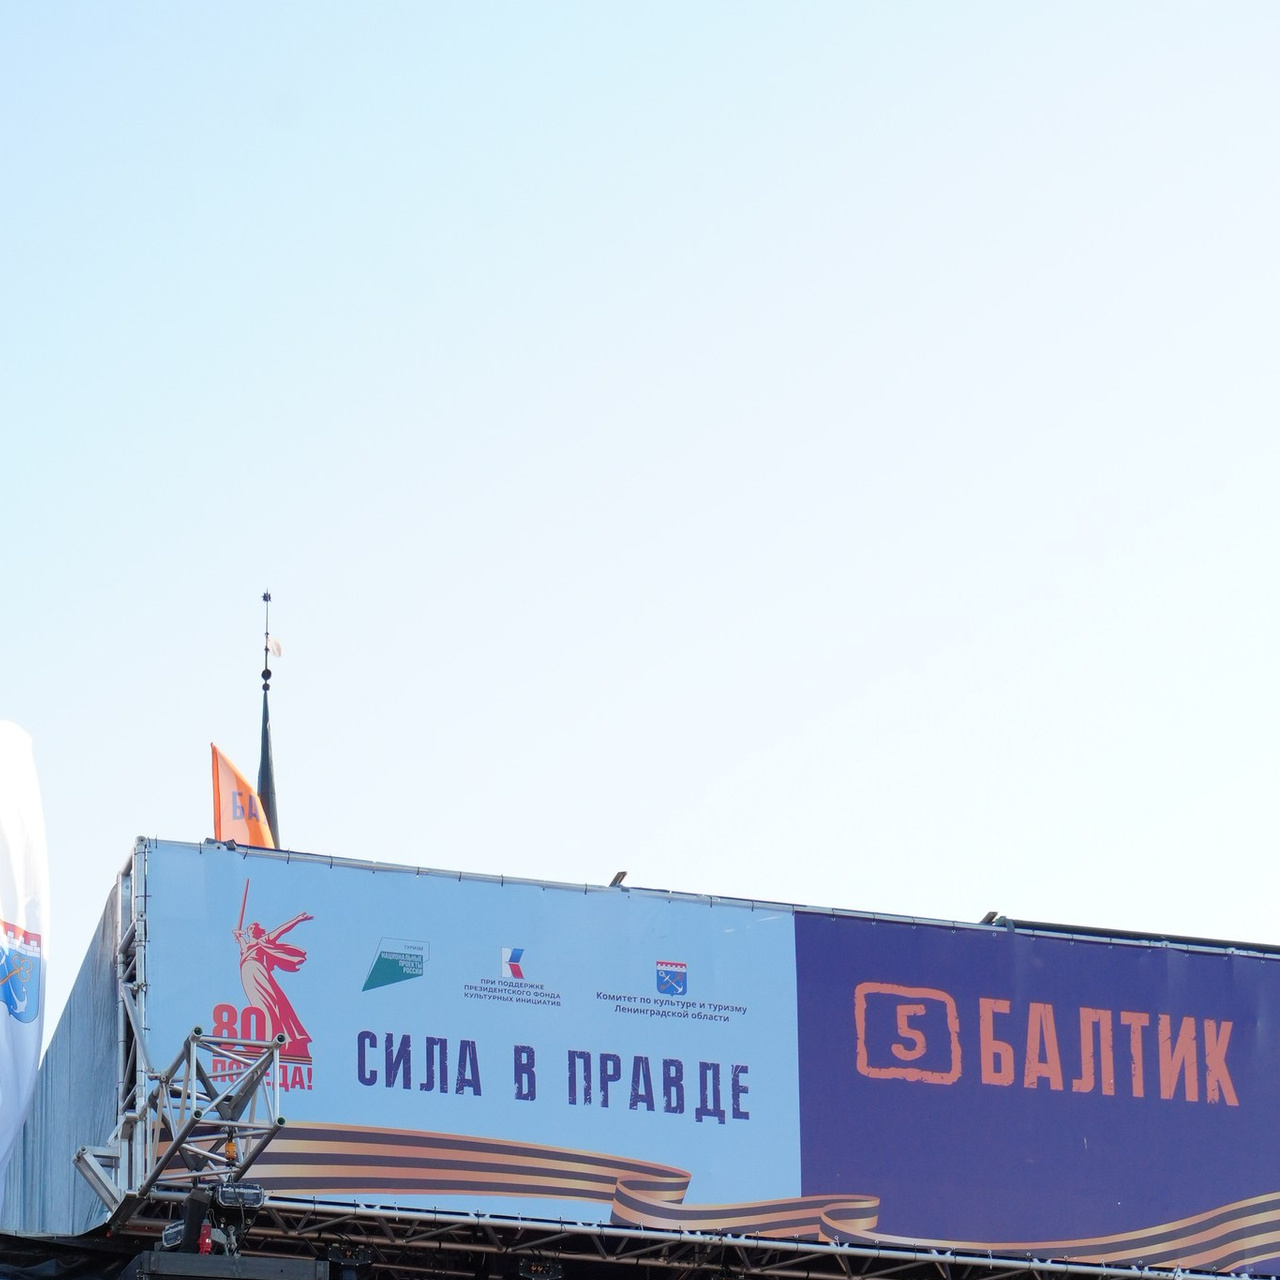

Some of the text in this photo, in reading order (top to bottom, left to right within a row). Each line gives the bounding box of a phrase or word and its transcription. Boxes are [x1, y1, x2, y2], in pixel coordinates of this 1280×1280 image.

[398, 960, 423, 969] ПРОЕКТЫ
[403, 967, 423, 975] РОССИИ
[464, 984, 561, 1000] ПРЕЗИДЕНТСКОГО ФОНДА
[480, 978, 545, 990] ПРИ ПОДДЕРЖКЕ
[464, 992, 561, 1007] КУЛЬТУРНЫХ ИНИЦИАТИВ
[596, 992, 637, 1003] Комитет
[640, 997, 651, 1005] по
[654, 998, 696, 1009] культуре
[708, 1002, 747, 1014] туризму
[614, 1004, 730, 1023] Ленинградской области
[212, 1003, 267, 1052] 80
[891, 997, 1239, 1107] 5 БАЛТИК
[212, 1058, 313, 1093] ПОДА!
[357, 1030, 751, 1125] СИЛА В ПРАВДЕ
